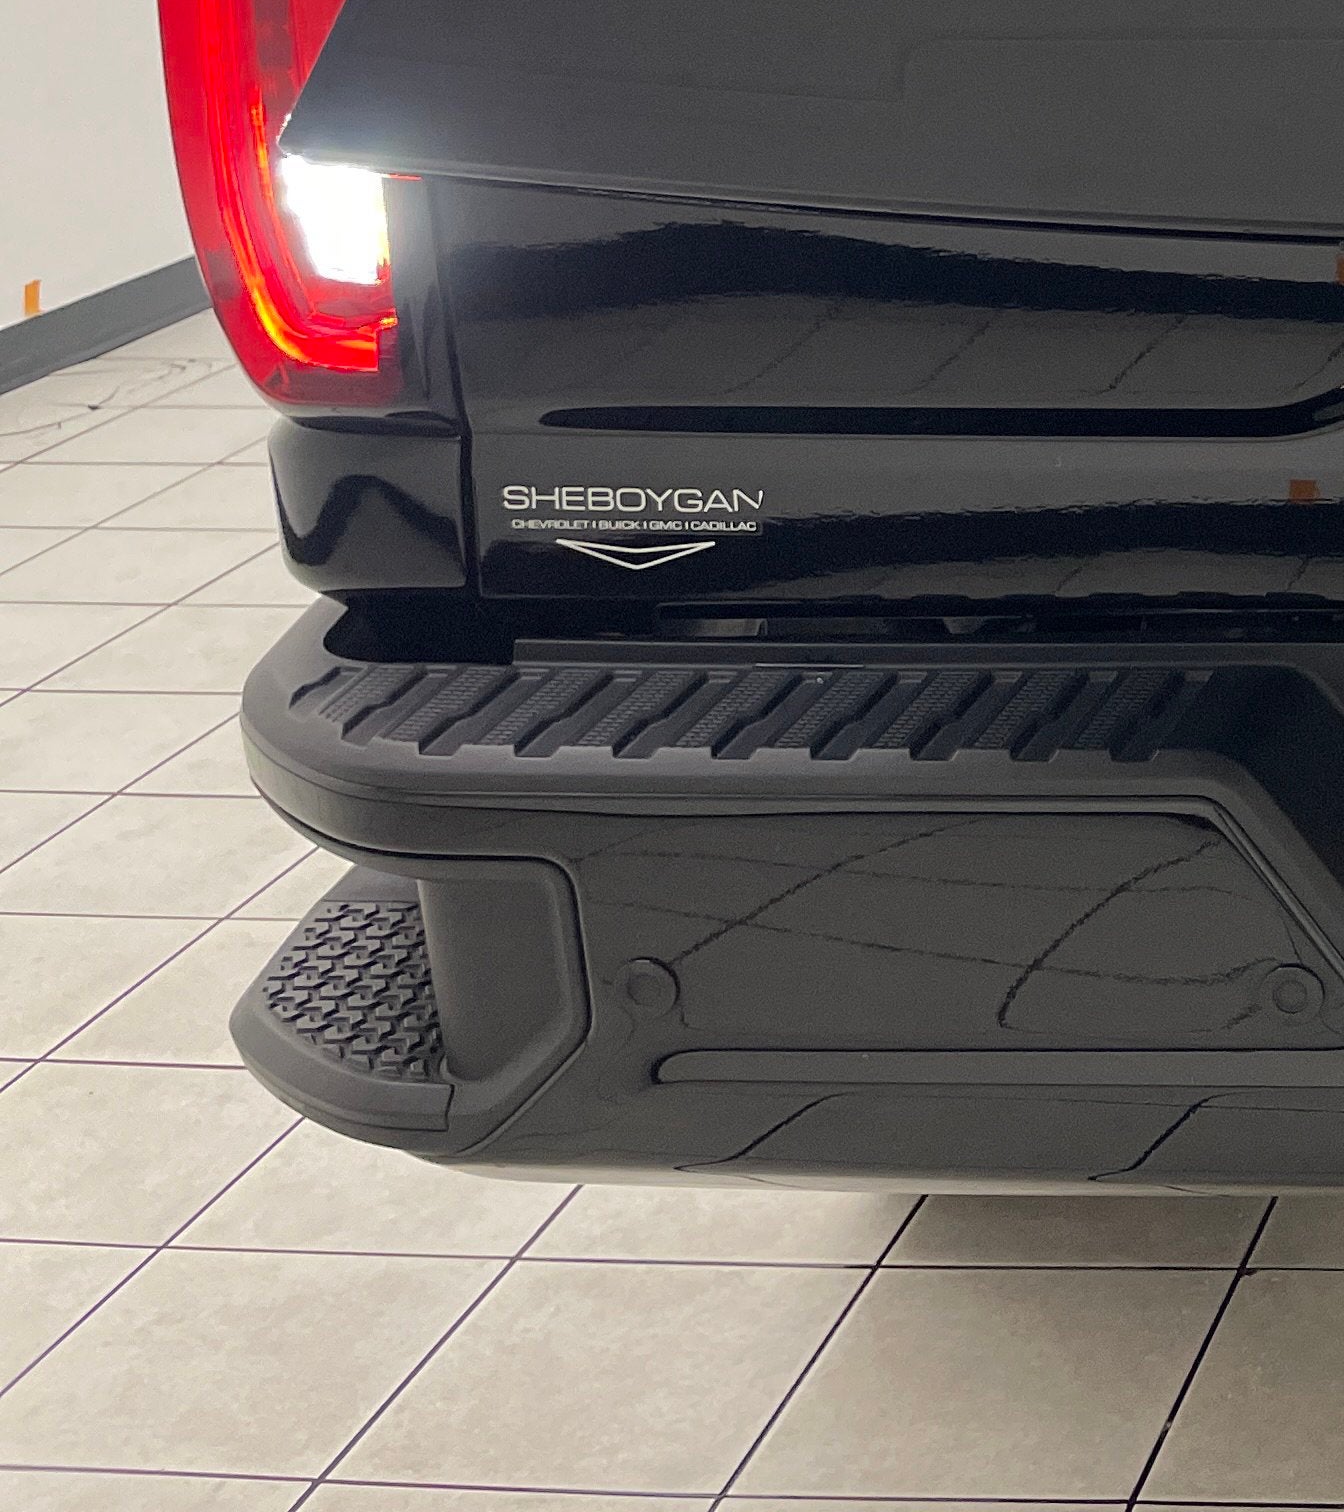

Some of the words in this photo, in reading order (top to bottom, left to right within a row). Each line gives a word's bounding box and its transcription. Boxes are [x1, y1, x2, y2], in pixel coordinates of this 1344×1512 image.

[503, 485, 764, 513] SHEBOYGAN
[511, 518, 589, 530] CHEVROLET
[599, 519, 640, 531] BUICK
[649, 520, 683, 531] GMC
[690, 521, 757, 532] CADILLAC
